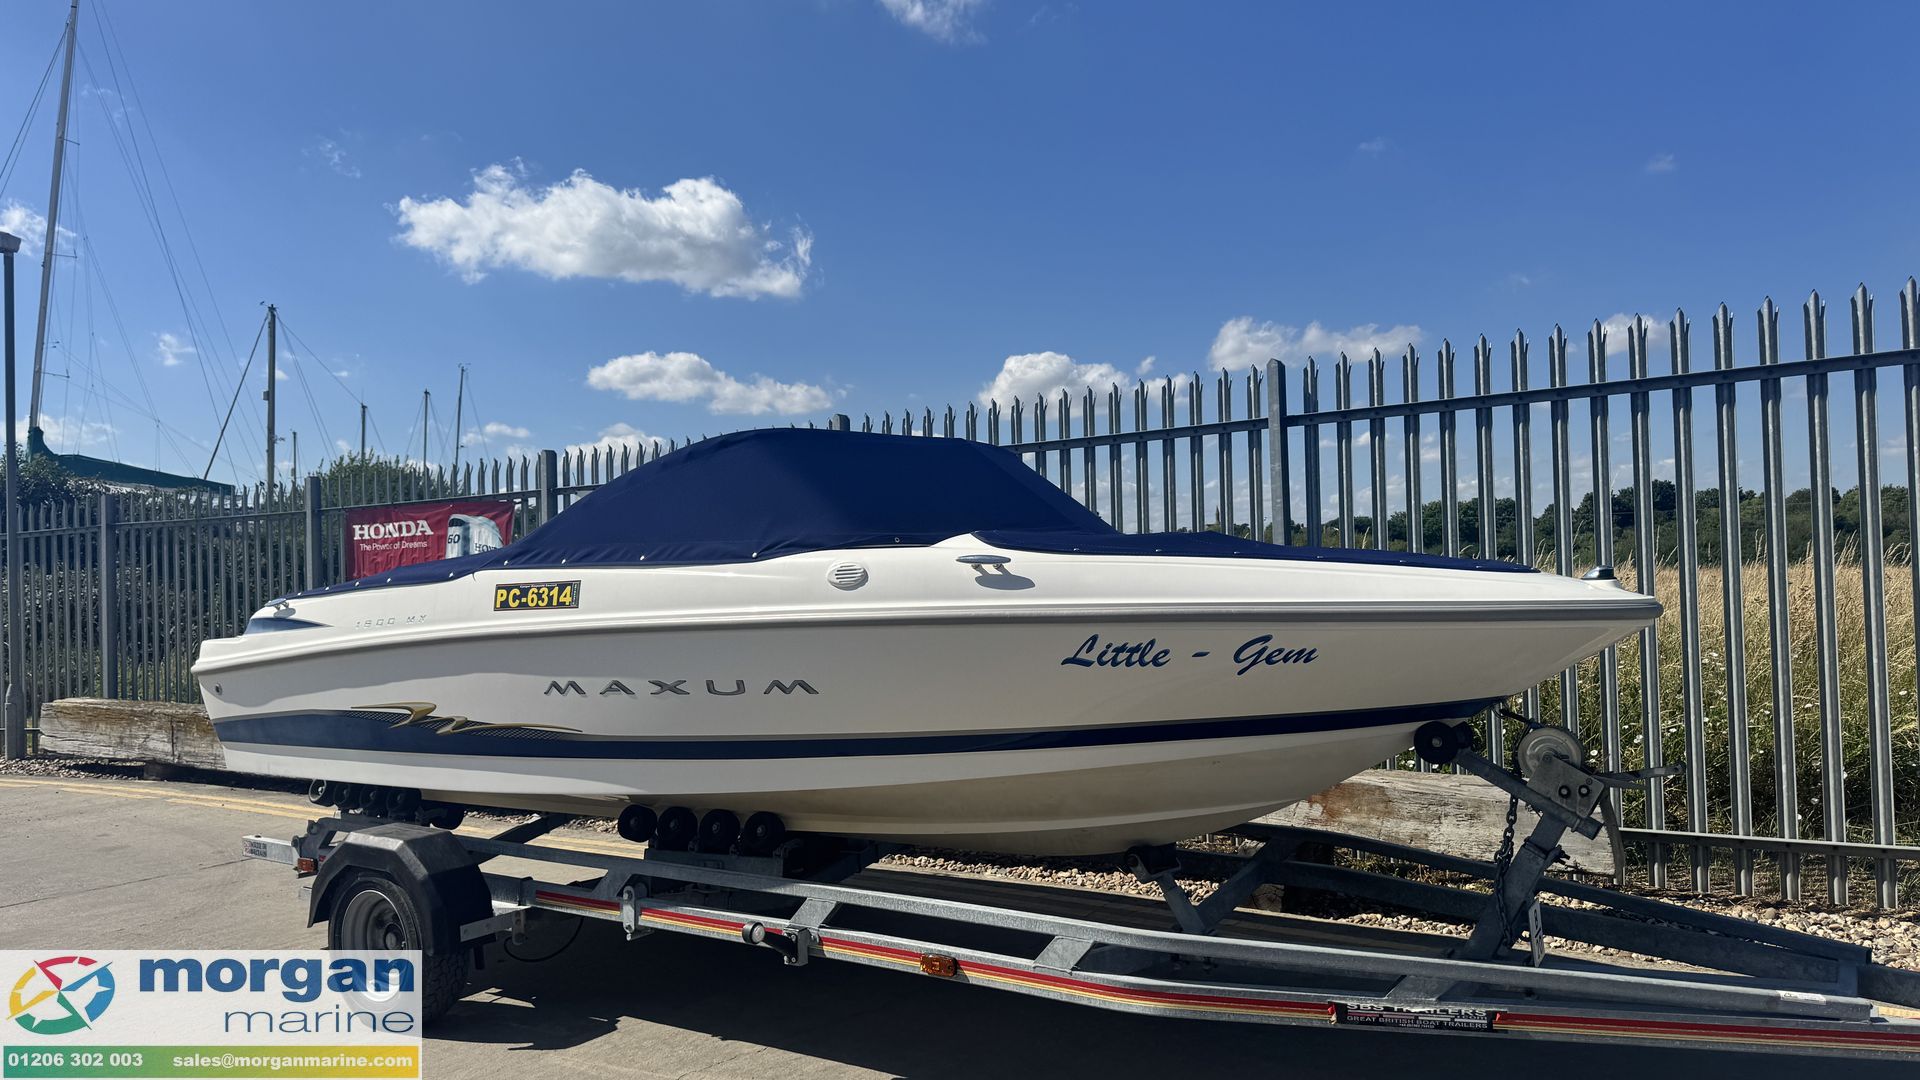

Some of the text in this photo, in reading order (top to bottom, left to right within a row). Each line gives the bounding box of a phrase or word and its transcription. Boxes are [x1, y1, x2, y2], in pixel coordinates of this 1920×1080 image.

[352, 519, 434, 541] HONDA
[360, 543, 371, 552] The
[393, 541, 400, 550] of
[401, 540, 428, 549] Dreams
[495, 585, 573, 609] PC-6314
[1061, 633, 1172, 668] Little
[1232, 634, 1319, 676] Gem
[543, 679, 820, 696] MAXUM
[1346, 1015, 1377, 1023] GREAT
[1378, 1017, 1414, 1025] BRITISH
[1442, 1020, 1488, 1029] TRAILERS
